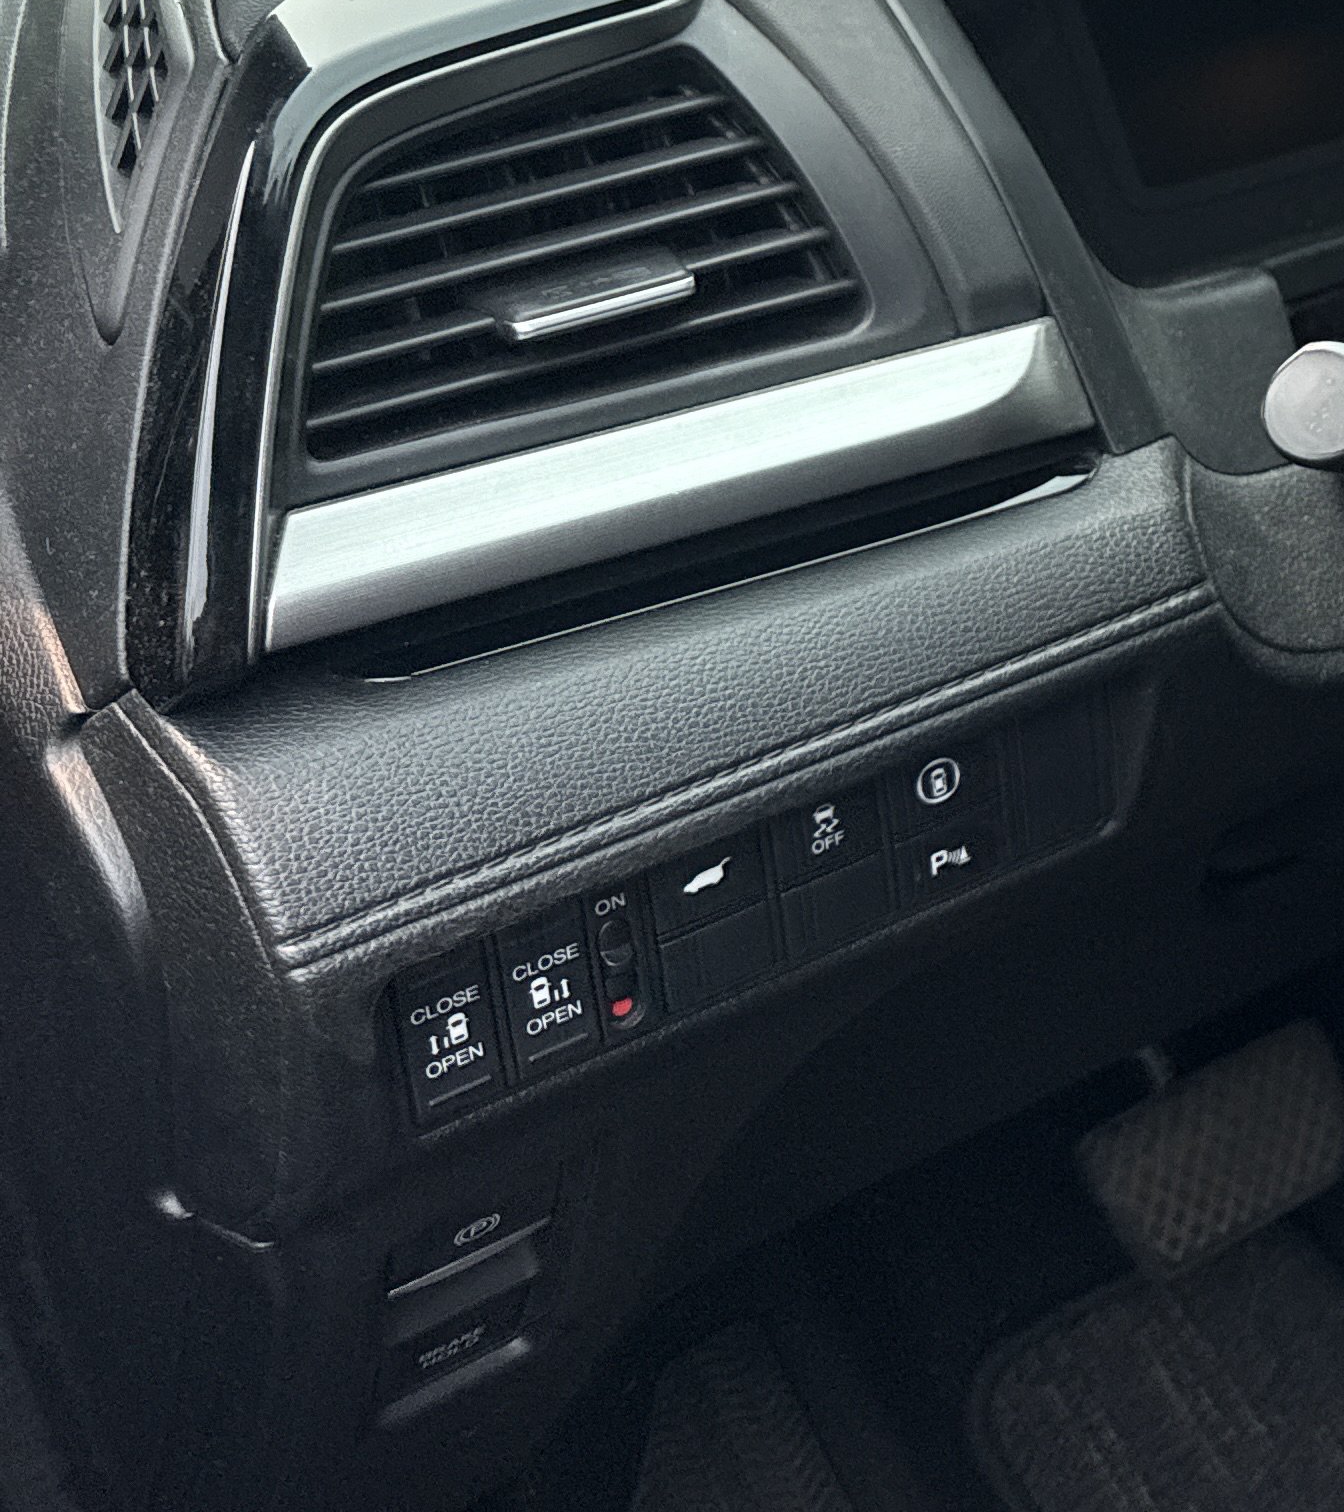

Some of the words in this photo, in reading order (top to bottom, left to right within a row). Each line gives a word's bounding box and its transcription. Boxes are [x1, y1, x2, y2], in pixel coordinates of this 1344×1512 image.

[811, 830, 845, 856] OFF
[594, 891, 627, 916] ON
[512, 941, 581, 983] CLOSE
[410, 984, 481, 1028] CLOSE
[525, 1000, 583, 1037] OPEN
[424, 1042, 486, 1080] OPEN
